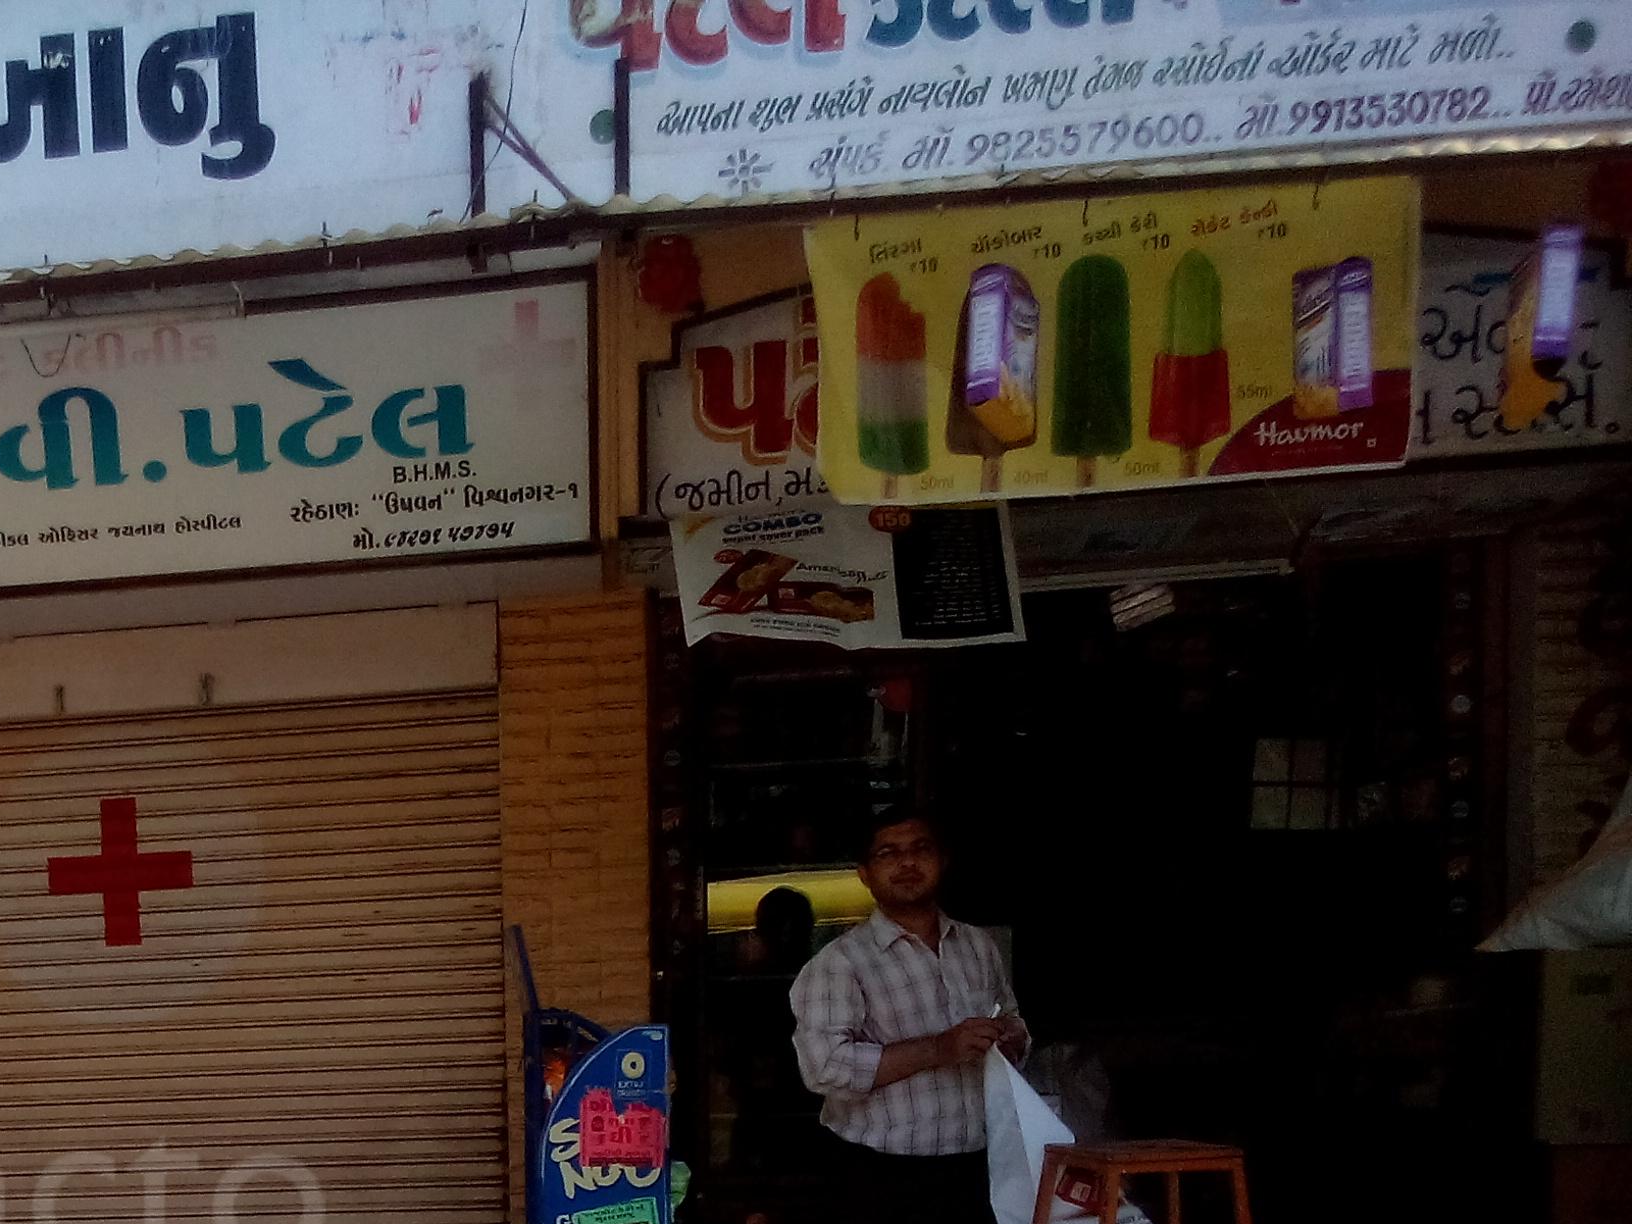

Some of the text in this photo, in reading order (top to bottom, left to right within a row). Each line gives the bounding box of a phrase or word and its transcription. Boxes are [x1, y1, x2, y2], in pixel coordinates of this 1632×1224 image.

[1254, 418, 1366, 449] Havmor
[392, 459, 478, 484] B.H.M.S.
[723, 512, 823, 535] COMBO
